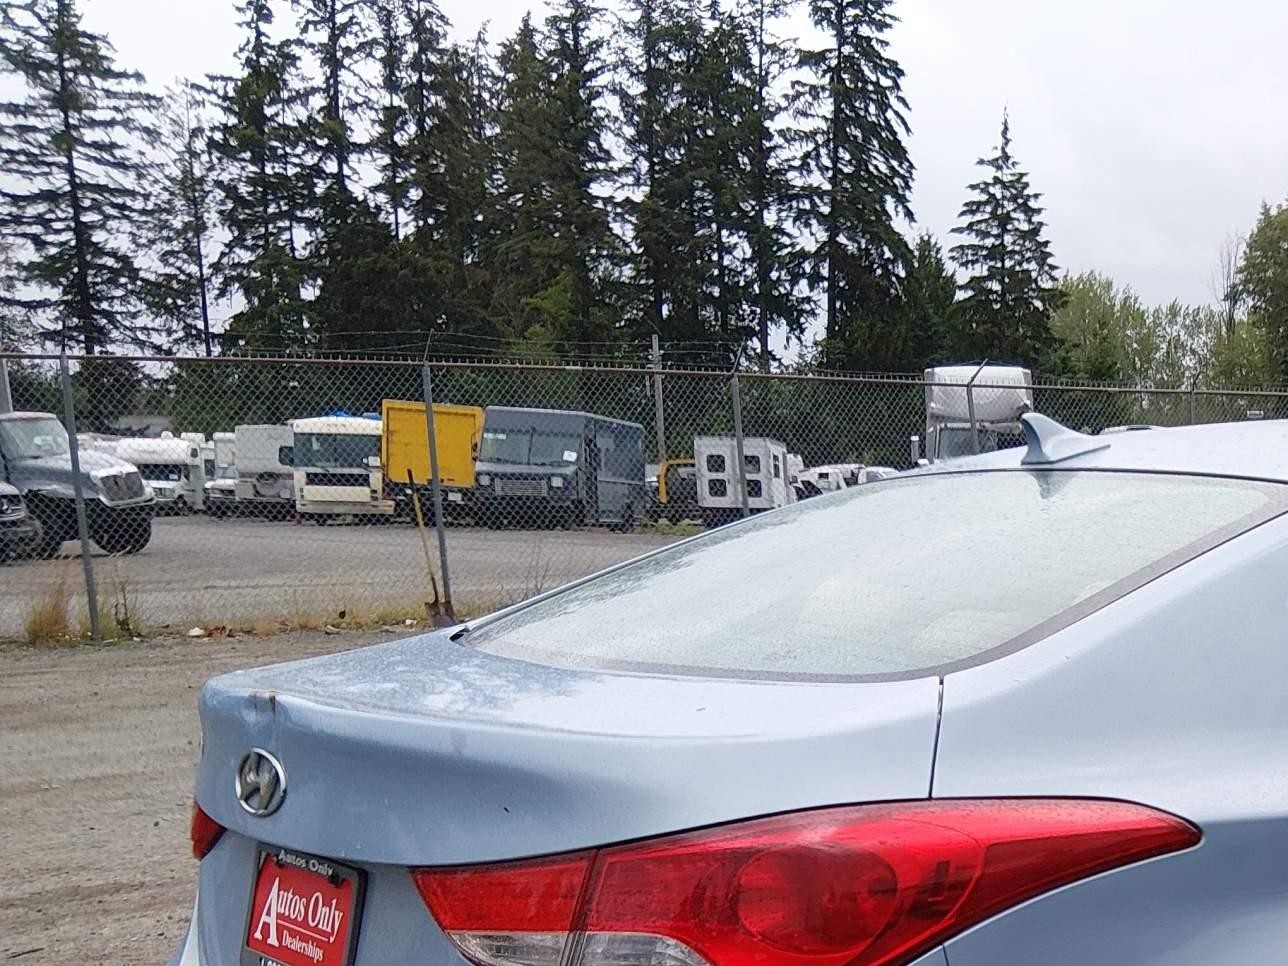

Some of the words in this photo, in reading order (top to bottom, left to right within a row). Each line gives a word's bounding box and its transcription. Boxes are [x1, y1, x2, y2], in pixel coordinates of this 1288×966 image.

[279, 850, 307, 867] Autos
[309, 859, 333, 876] Only
[254, 876, 307, 947] Autos
[308, 892, 343, 944] Only
[282, 929, 324, 964] Dealerships
